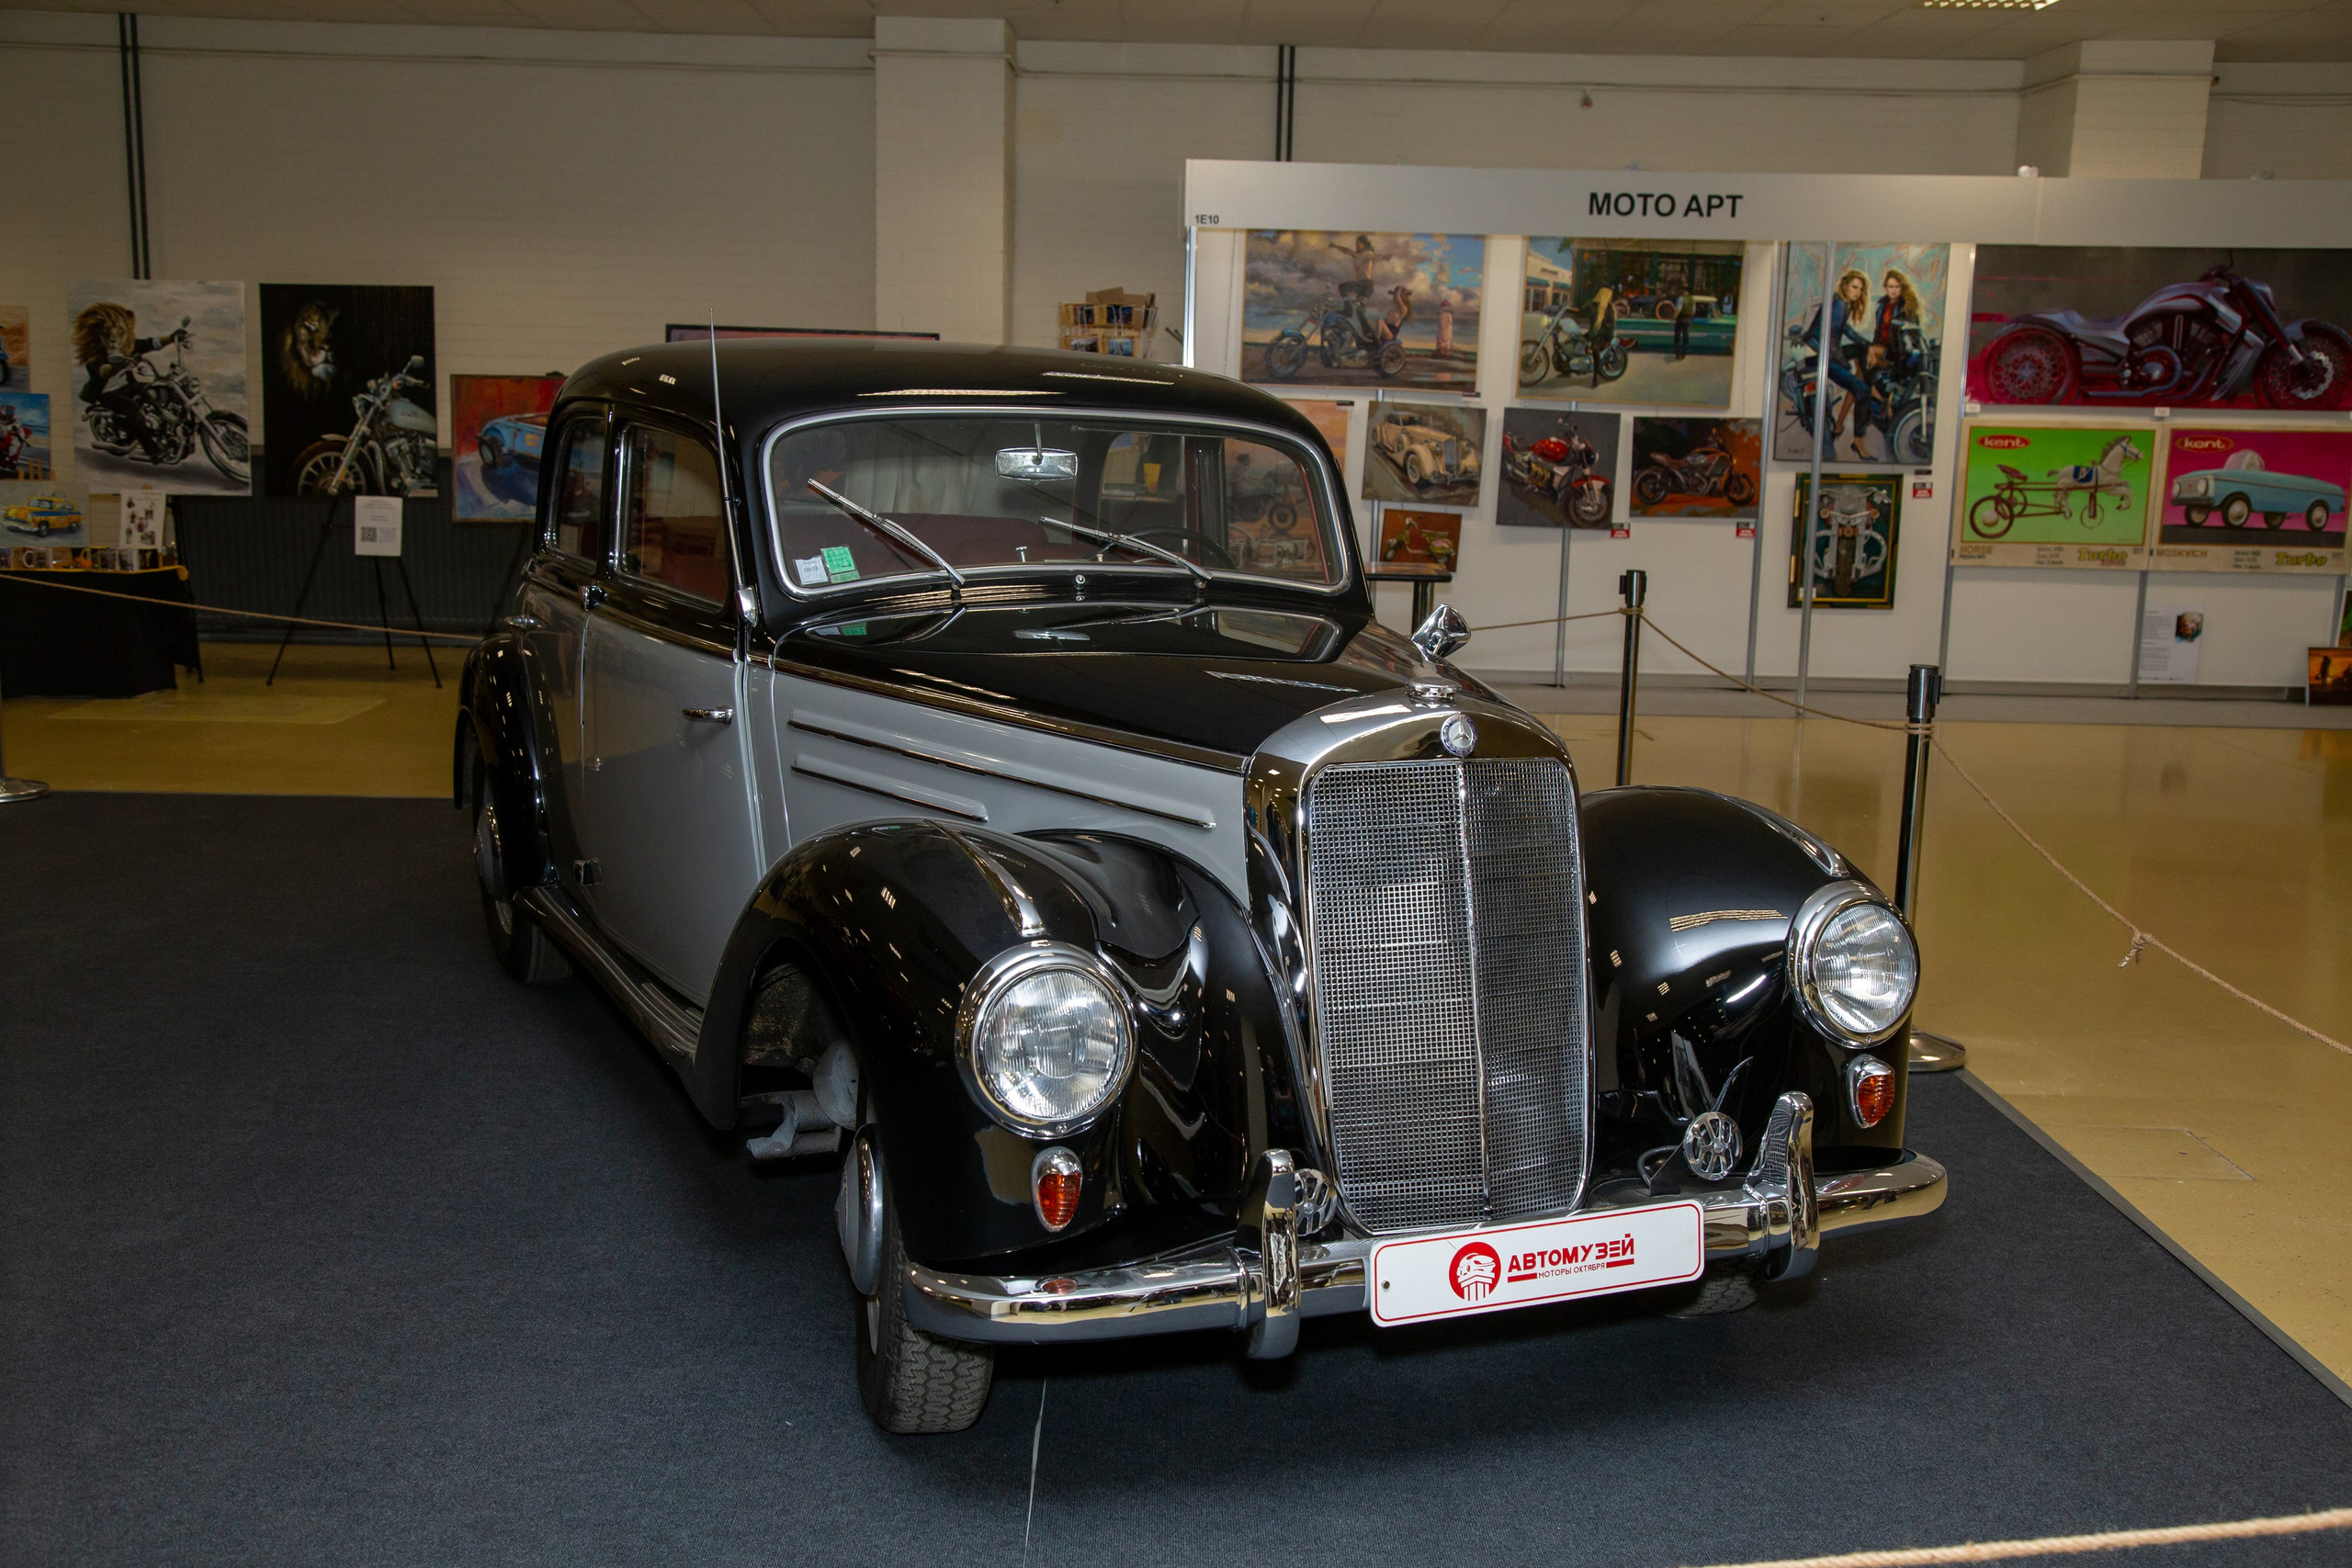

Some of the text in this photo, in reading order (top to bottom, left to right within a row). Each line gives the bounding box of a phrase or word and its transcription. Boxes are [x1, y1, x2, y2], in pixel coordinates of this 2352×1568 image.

[1589, 192, 1744, 218] МОТО АРТ
[1195, 214, 1220, 225] 1E10
[1984, 437, 2025, 448] kent
[2184, 437, 2226, 449] kent
[1960, 545, 1993, 555] HORSE
[2077, 547, 2129, 561] Turbo
[2156, 548, 2209, 558] MOSKVICH
[2275, 551, 2328, 567] Turbo
[1507, 1233, 1635, 1273] АВТОМУЗЕЙ
[1538, 1262, 1605, 1279] МОТОРЫ ОКТЯБРЯ
